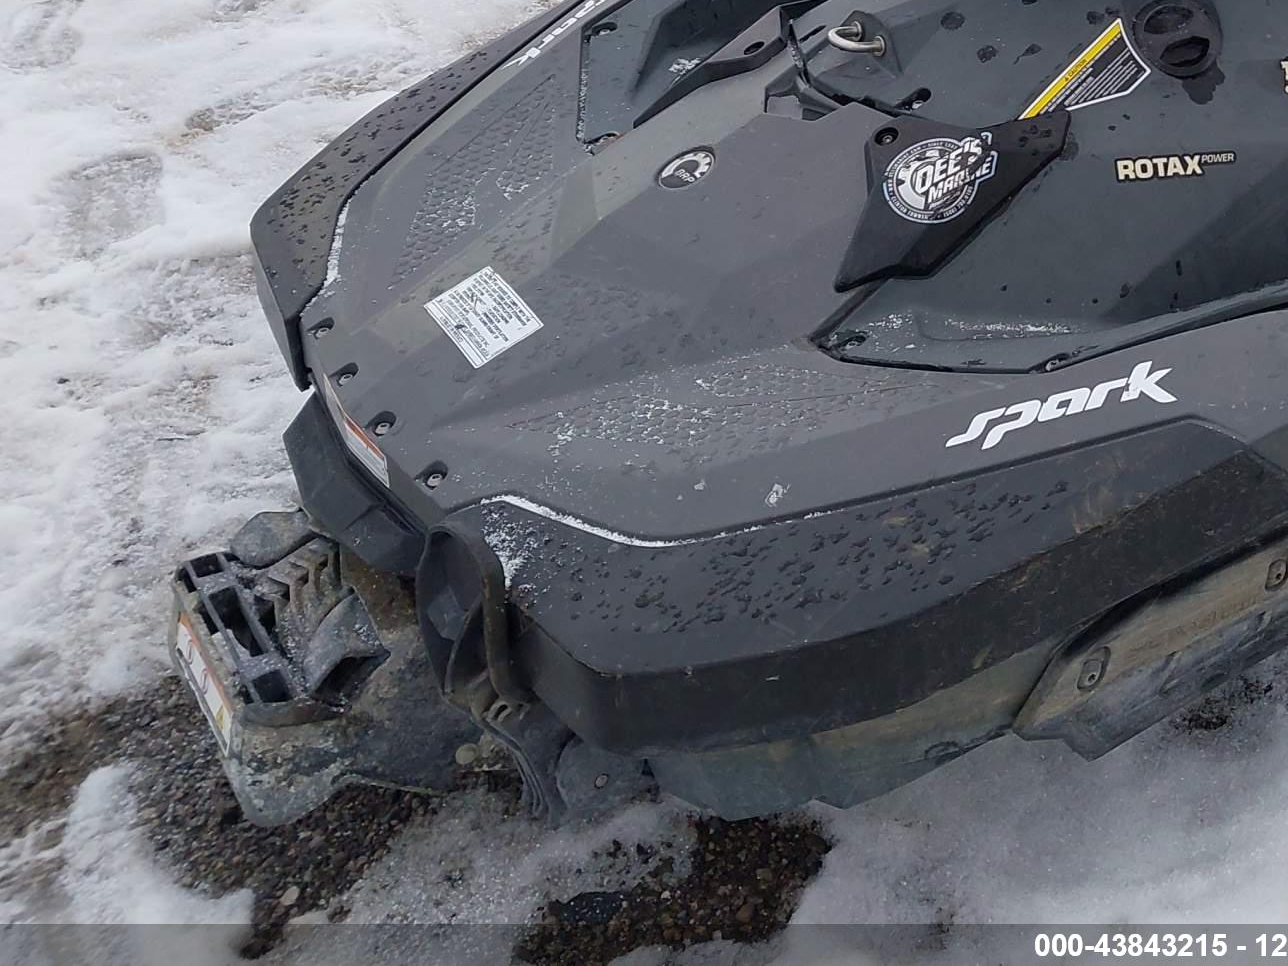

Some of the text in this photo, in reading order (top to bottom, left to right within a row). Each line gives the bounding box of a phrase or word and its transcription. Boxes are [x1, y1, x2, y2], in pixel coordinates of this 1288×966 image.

[674, 168, 696, 183] BRP
[1117, 153, 1235, 180] ROTAX POWER
